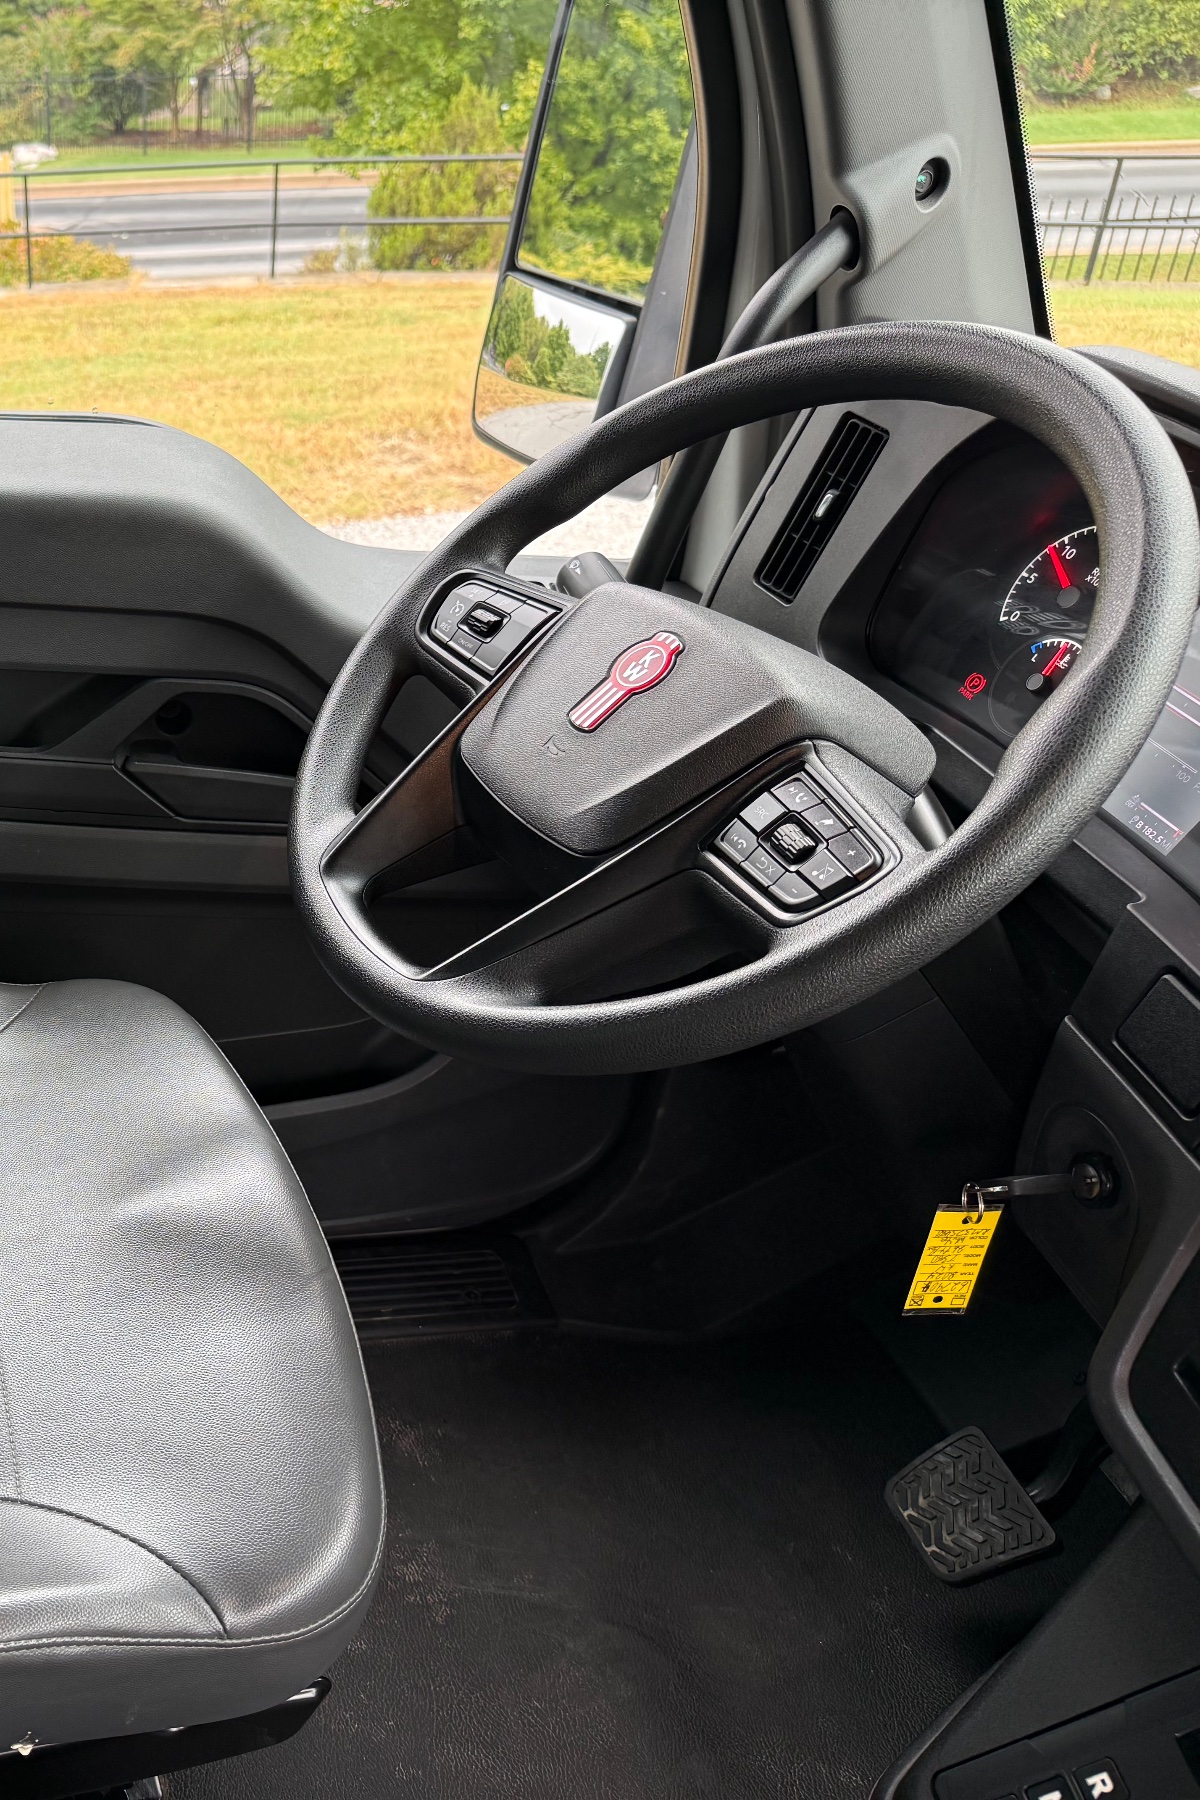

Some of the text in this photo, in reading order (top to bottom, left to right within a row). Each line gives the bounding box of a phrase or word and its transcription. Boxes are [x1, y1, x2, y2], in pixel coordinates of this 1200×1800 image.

[1061, 545, 1077, 560] 10
[1027, 572, 1036, 584] 5
[1009, 610, 1021, 622] 0
[439, 622, 451, 632] RES
[957, 686, 975, 701] PARK
[1176, 770, 1191, 783] 100
[753, 805, 769, 820] SRC
[1135, 820, 1173, 851] B 182.5 MI
[1084, 1770, 1115, 1800] R
